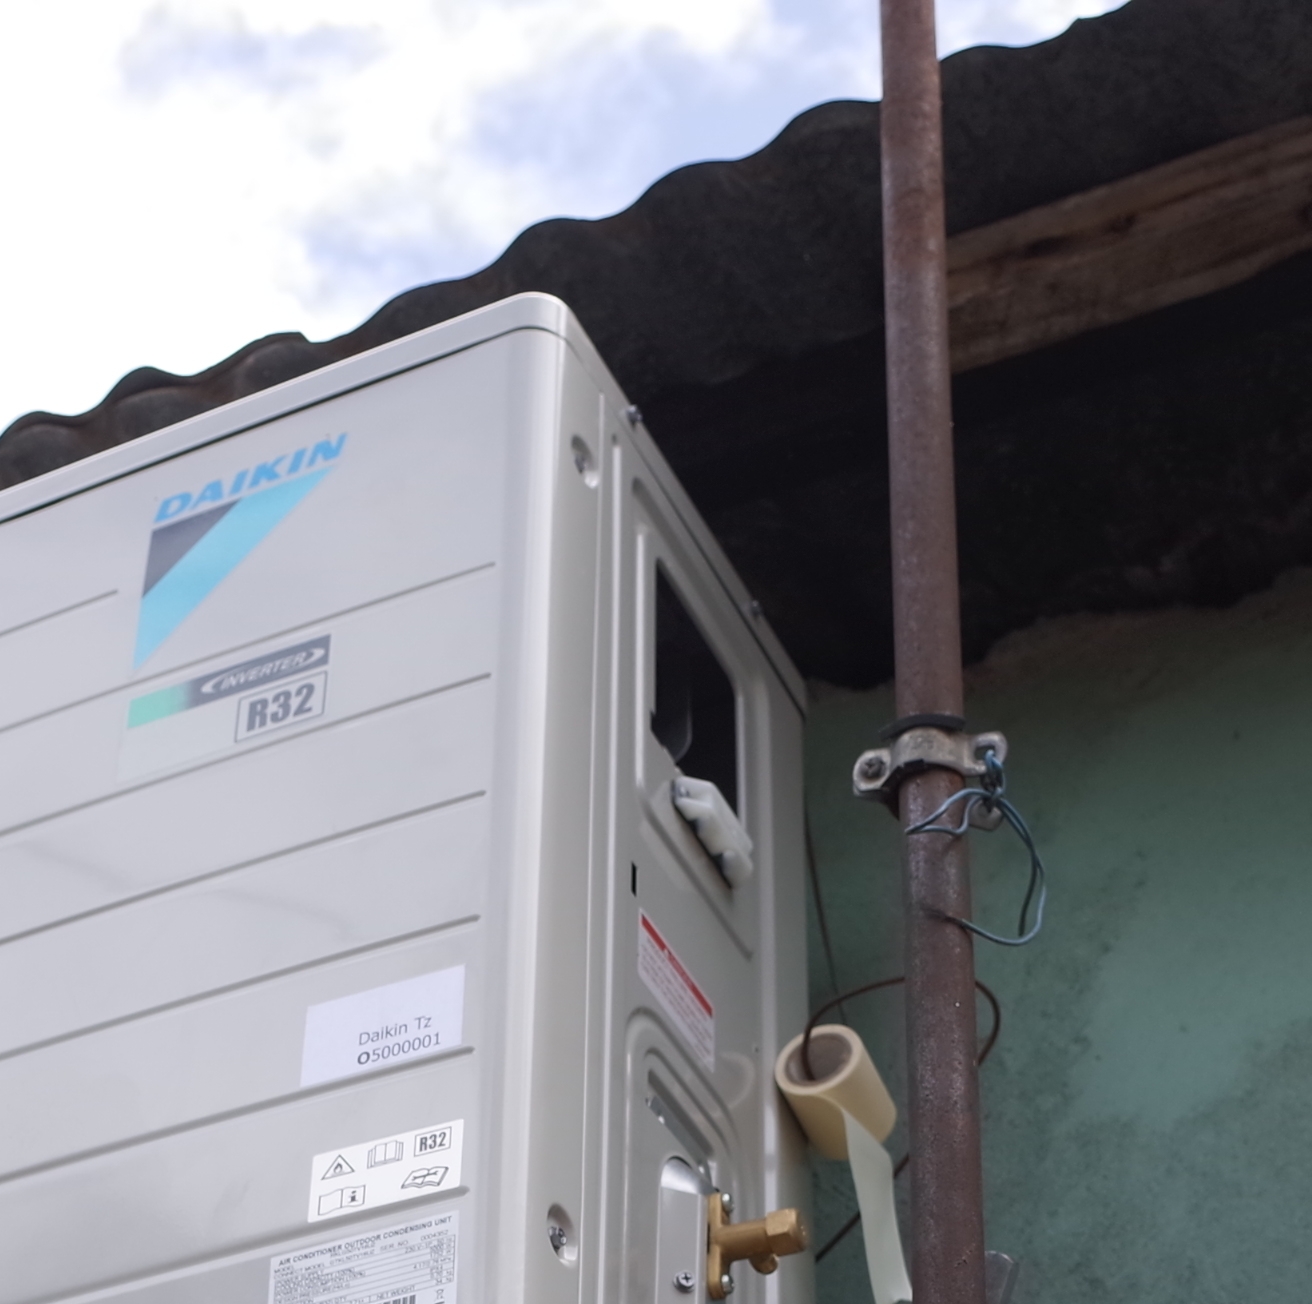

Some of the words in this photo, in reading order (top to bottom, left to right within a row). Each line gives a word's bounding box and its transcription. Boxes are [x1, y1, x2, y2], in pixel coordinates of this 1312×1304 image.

[152, 431, 349, 524] DAIKIN
[220, 650, 310, 691] INVERTER
[246, 682, 316, 733] R32
[358, 1022, 408, 1047] Daikin
[414, 1015, 433, 1030] Tz
[419, 1131, 447, 1152] R32
[278, 1257, 291, 1267] AIR
[292, 1243, 342, 1263] CONDITIONER
[343, 1233, 381, 1250] OUTDOOR
[382, 1220, 432, 1239] CONDENSING
[433, 1215, 452, 1226] UNIT
